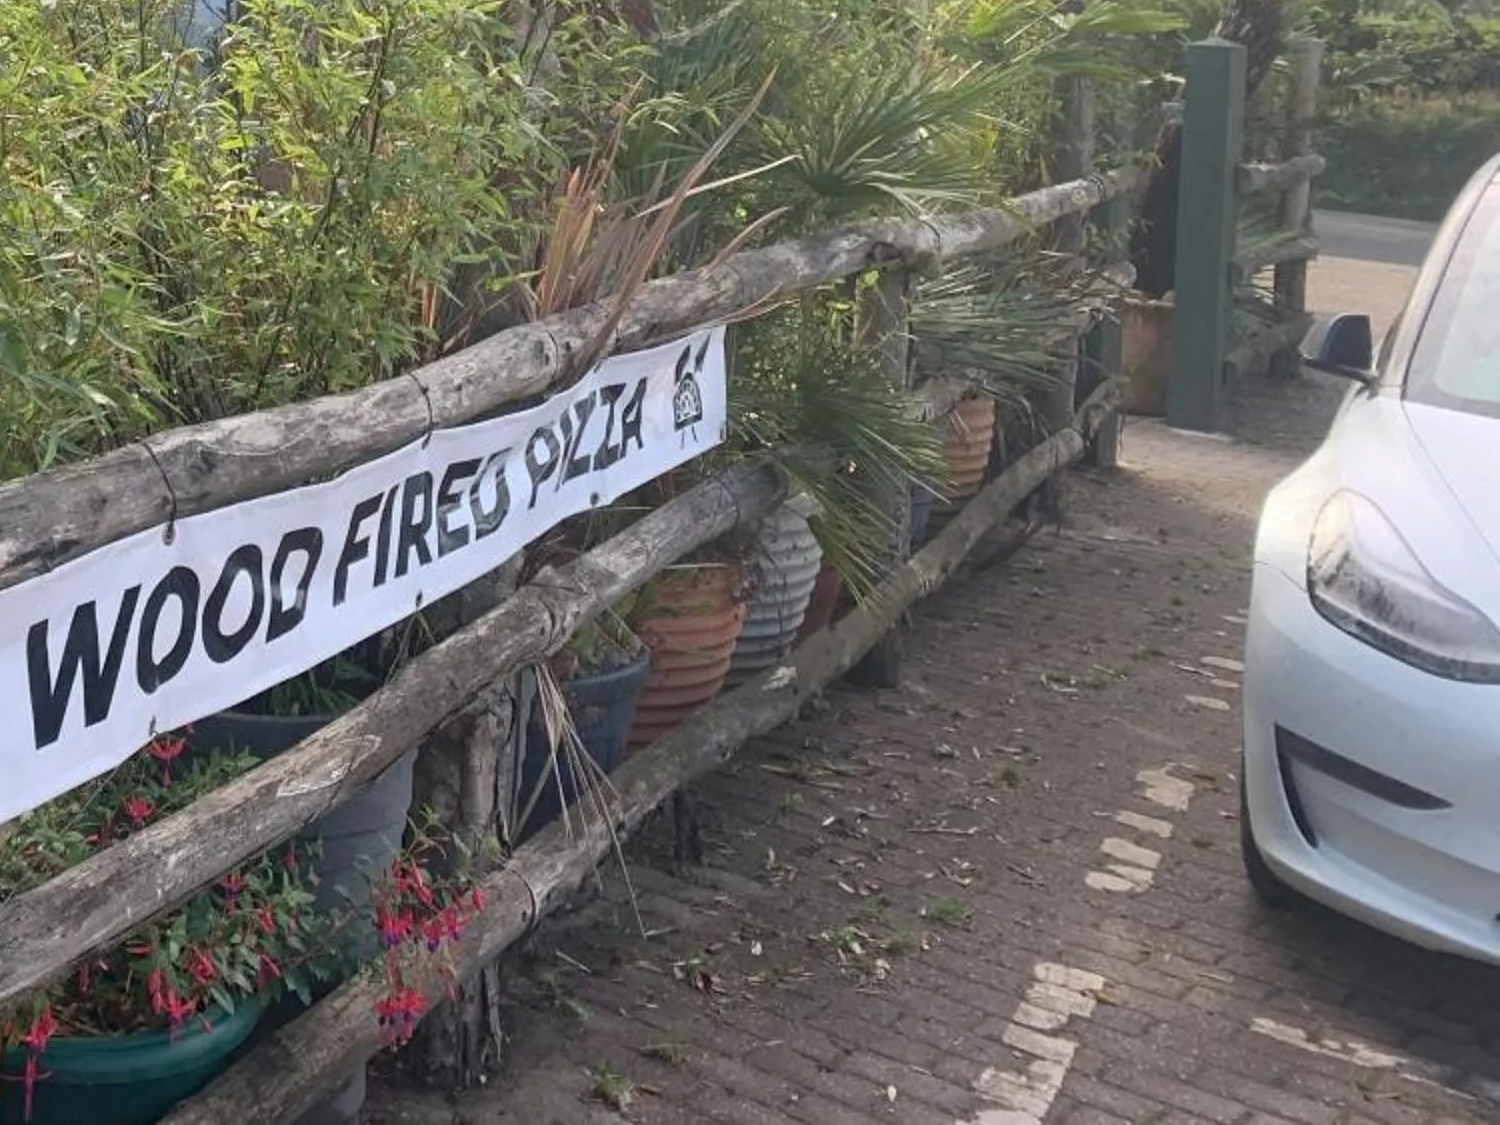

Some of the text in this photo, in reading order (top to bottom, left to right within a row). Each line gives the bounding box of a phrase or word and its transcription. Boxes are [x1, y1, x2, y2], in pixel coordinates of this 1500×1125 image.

[26, 376, 649, 751] WOOD FIRED PIZZA
